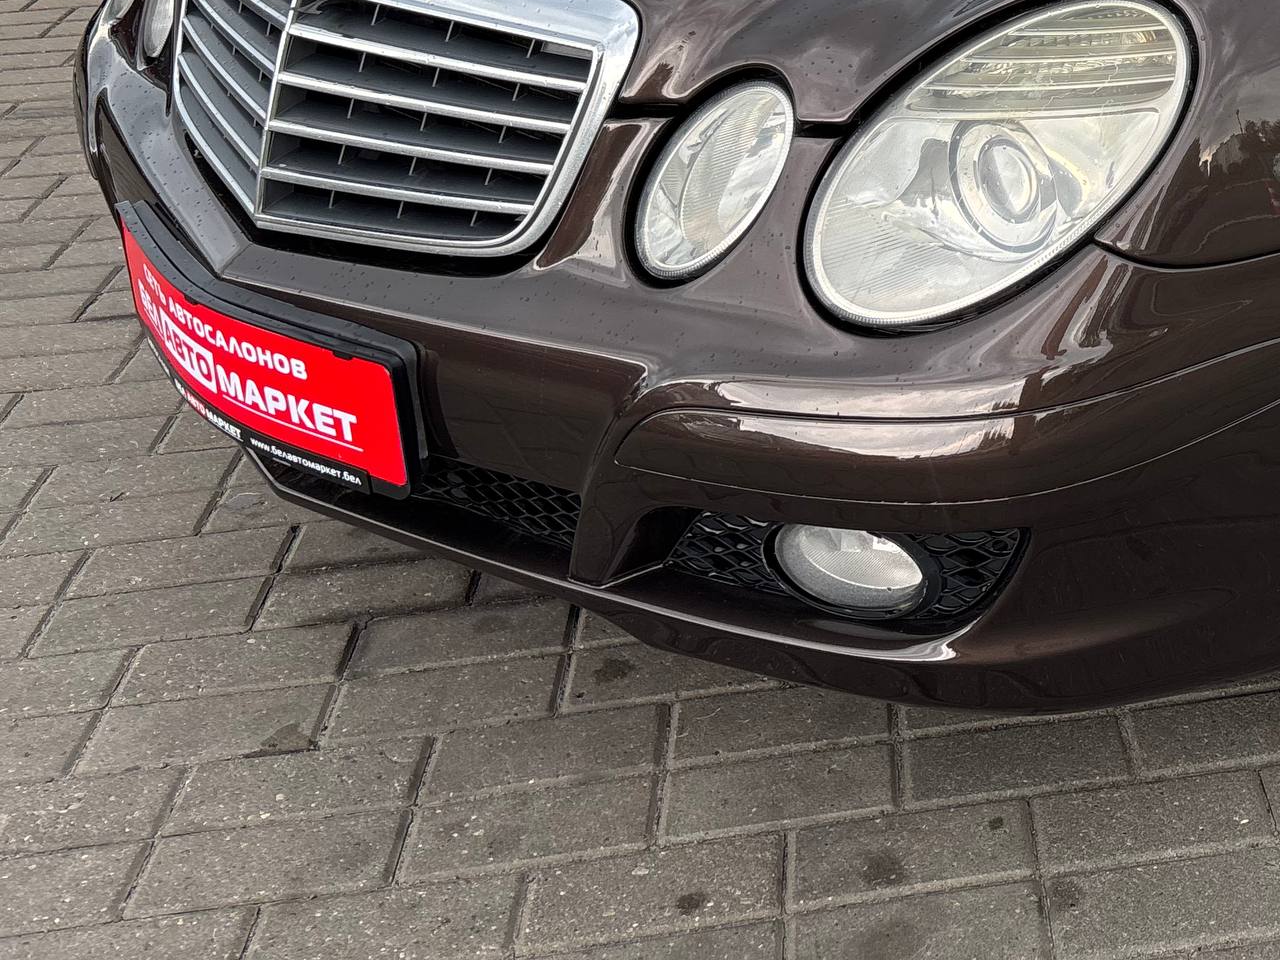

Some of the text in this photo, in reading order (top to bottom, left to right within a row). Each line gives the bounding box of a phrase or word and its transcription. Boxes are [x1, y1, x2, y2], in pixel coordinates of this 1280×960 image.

[143, 263, 167, 306] СЕТЬ
[168, 296, 308, 381] АВТОСАЛОНОВ
[250, 437, 362, 486] www.белавтомаркет.бел
